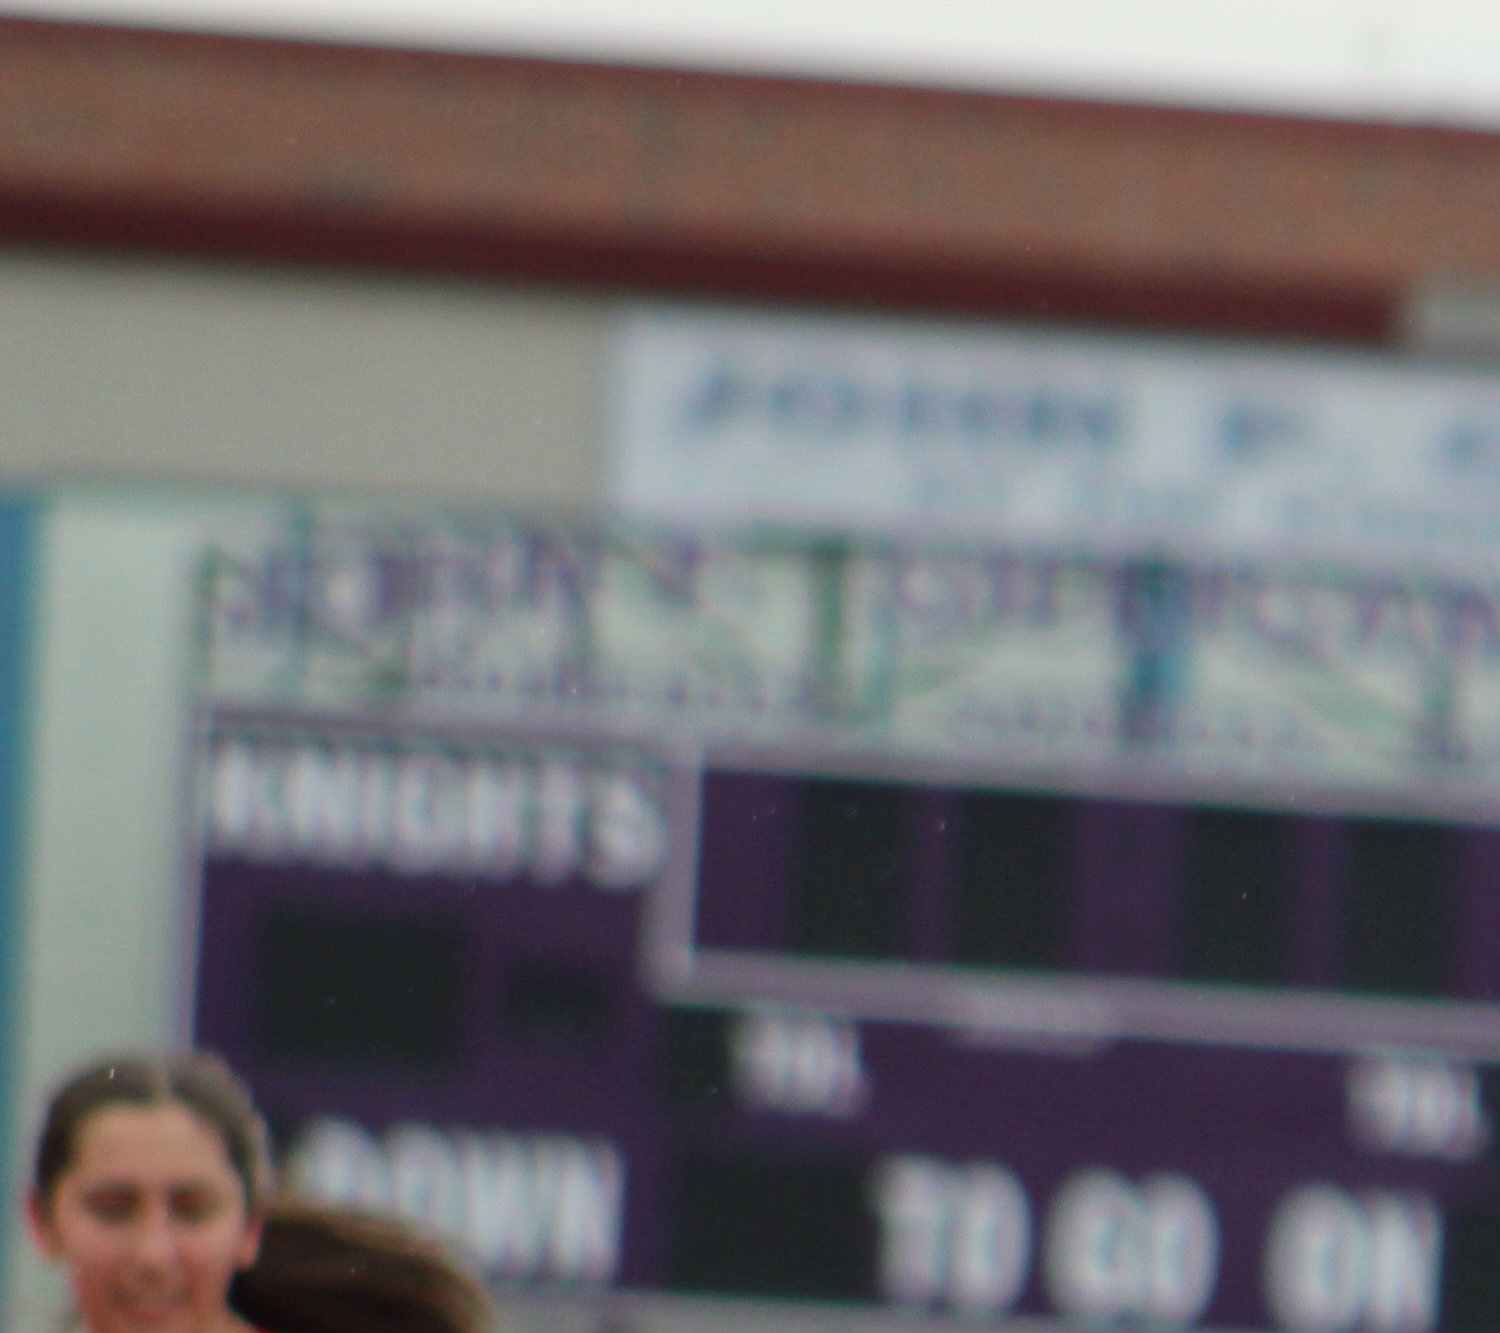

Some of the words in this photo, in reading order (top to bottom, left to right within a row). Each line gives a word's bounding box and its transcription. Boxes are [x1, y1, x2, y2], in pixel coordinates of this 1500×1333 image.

[211, 742, 668, 892] KNIGHTS
[290, 1118, 624, 1282] DOWN
[874, 1156, 1032, 1315] TO
[1043, 1167, 1221, 1333] GO
